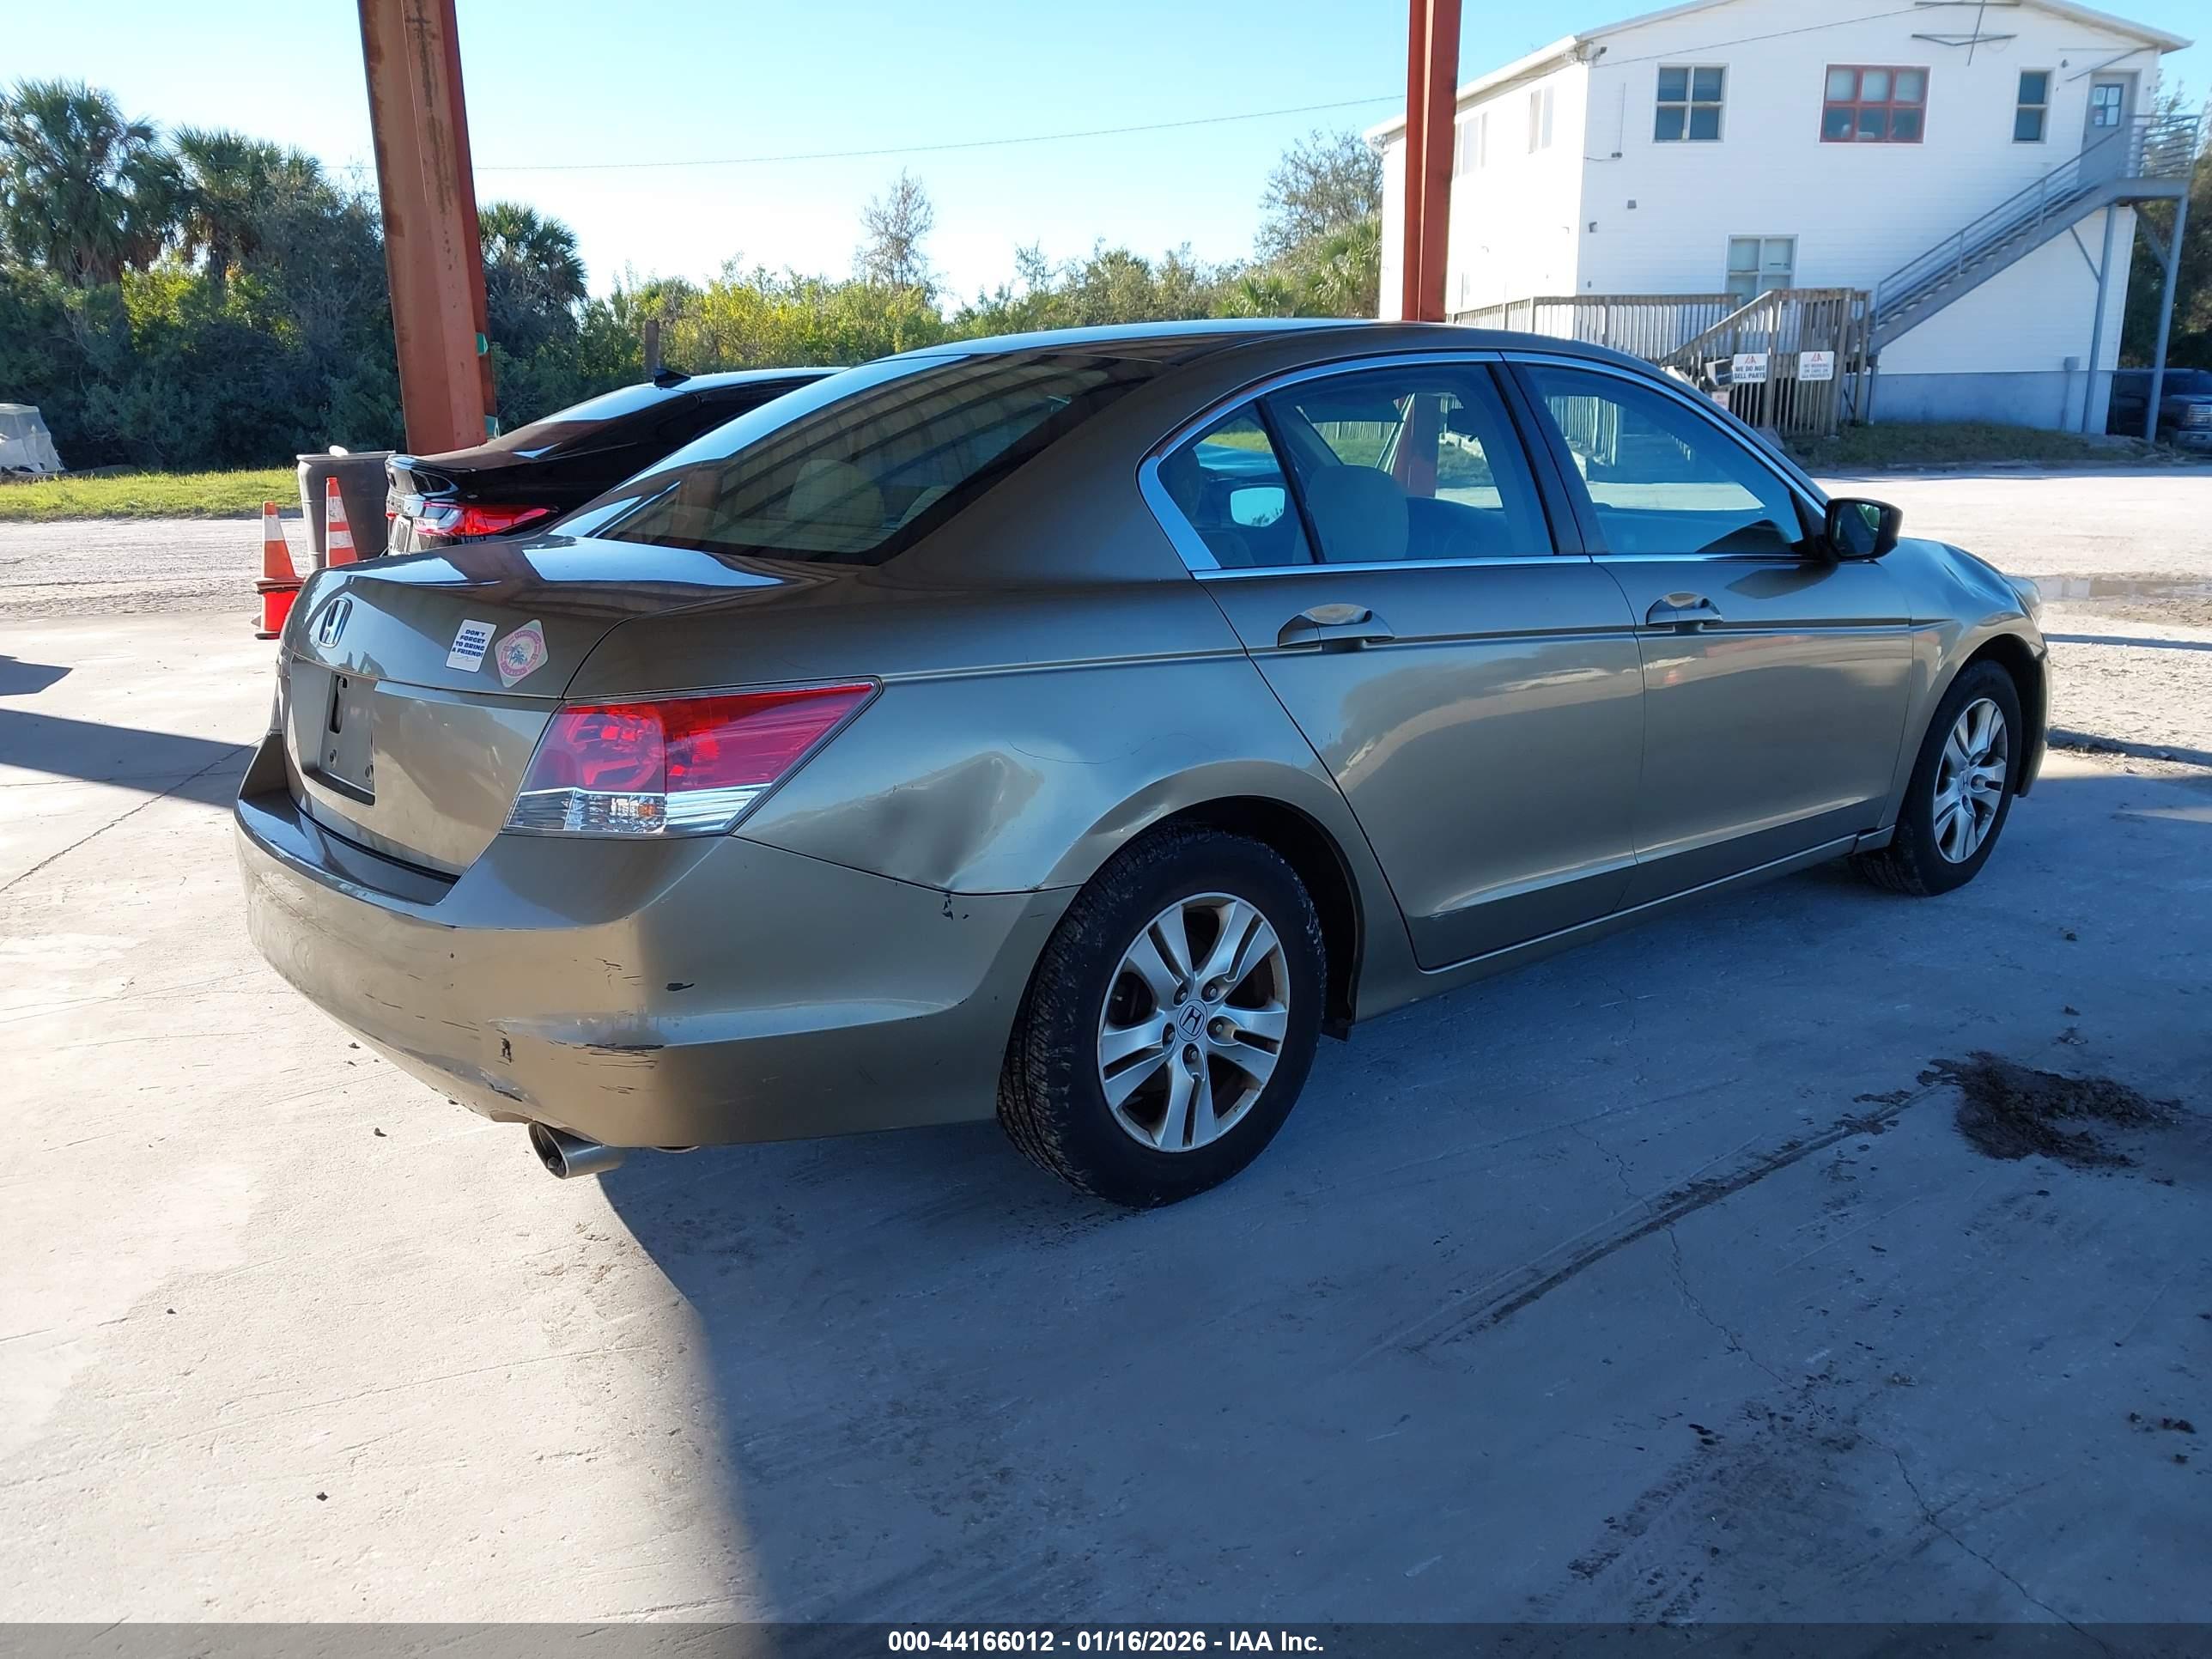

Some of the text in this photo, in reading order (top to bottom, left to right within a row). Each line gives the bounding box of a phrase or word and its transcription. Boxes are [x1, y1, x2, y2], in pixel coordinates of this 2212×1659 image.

[459, 635, 486, 644] FORGET
[464, 642, 485, 651] BRING
[457, 648, 483, 658] FRIEND!
